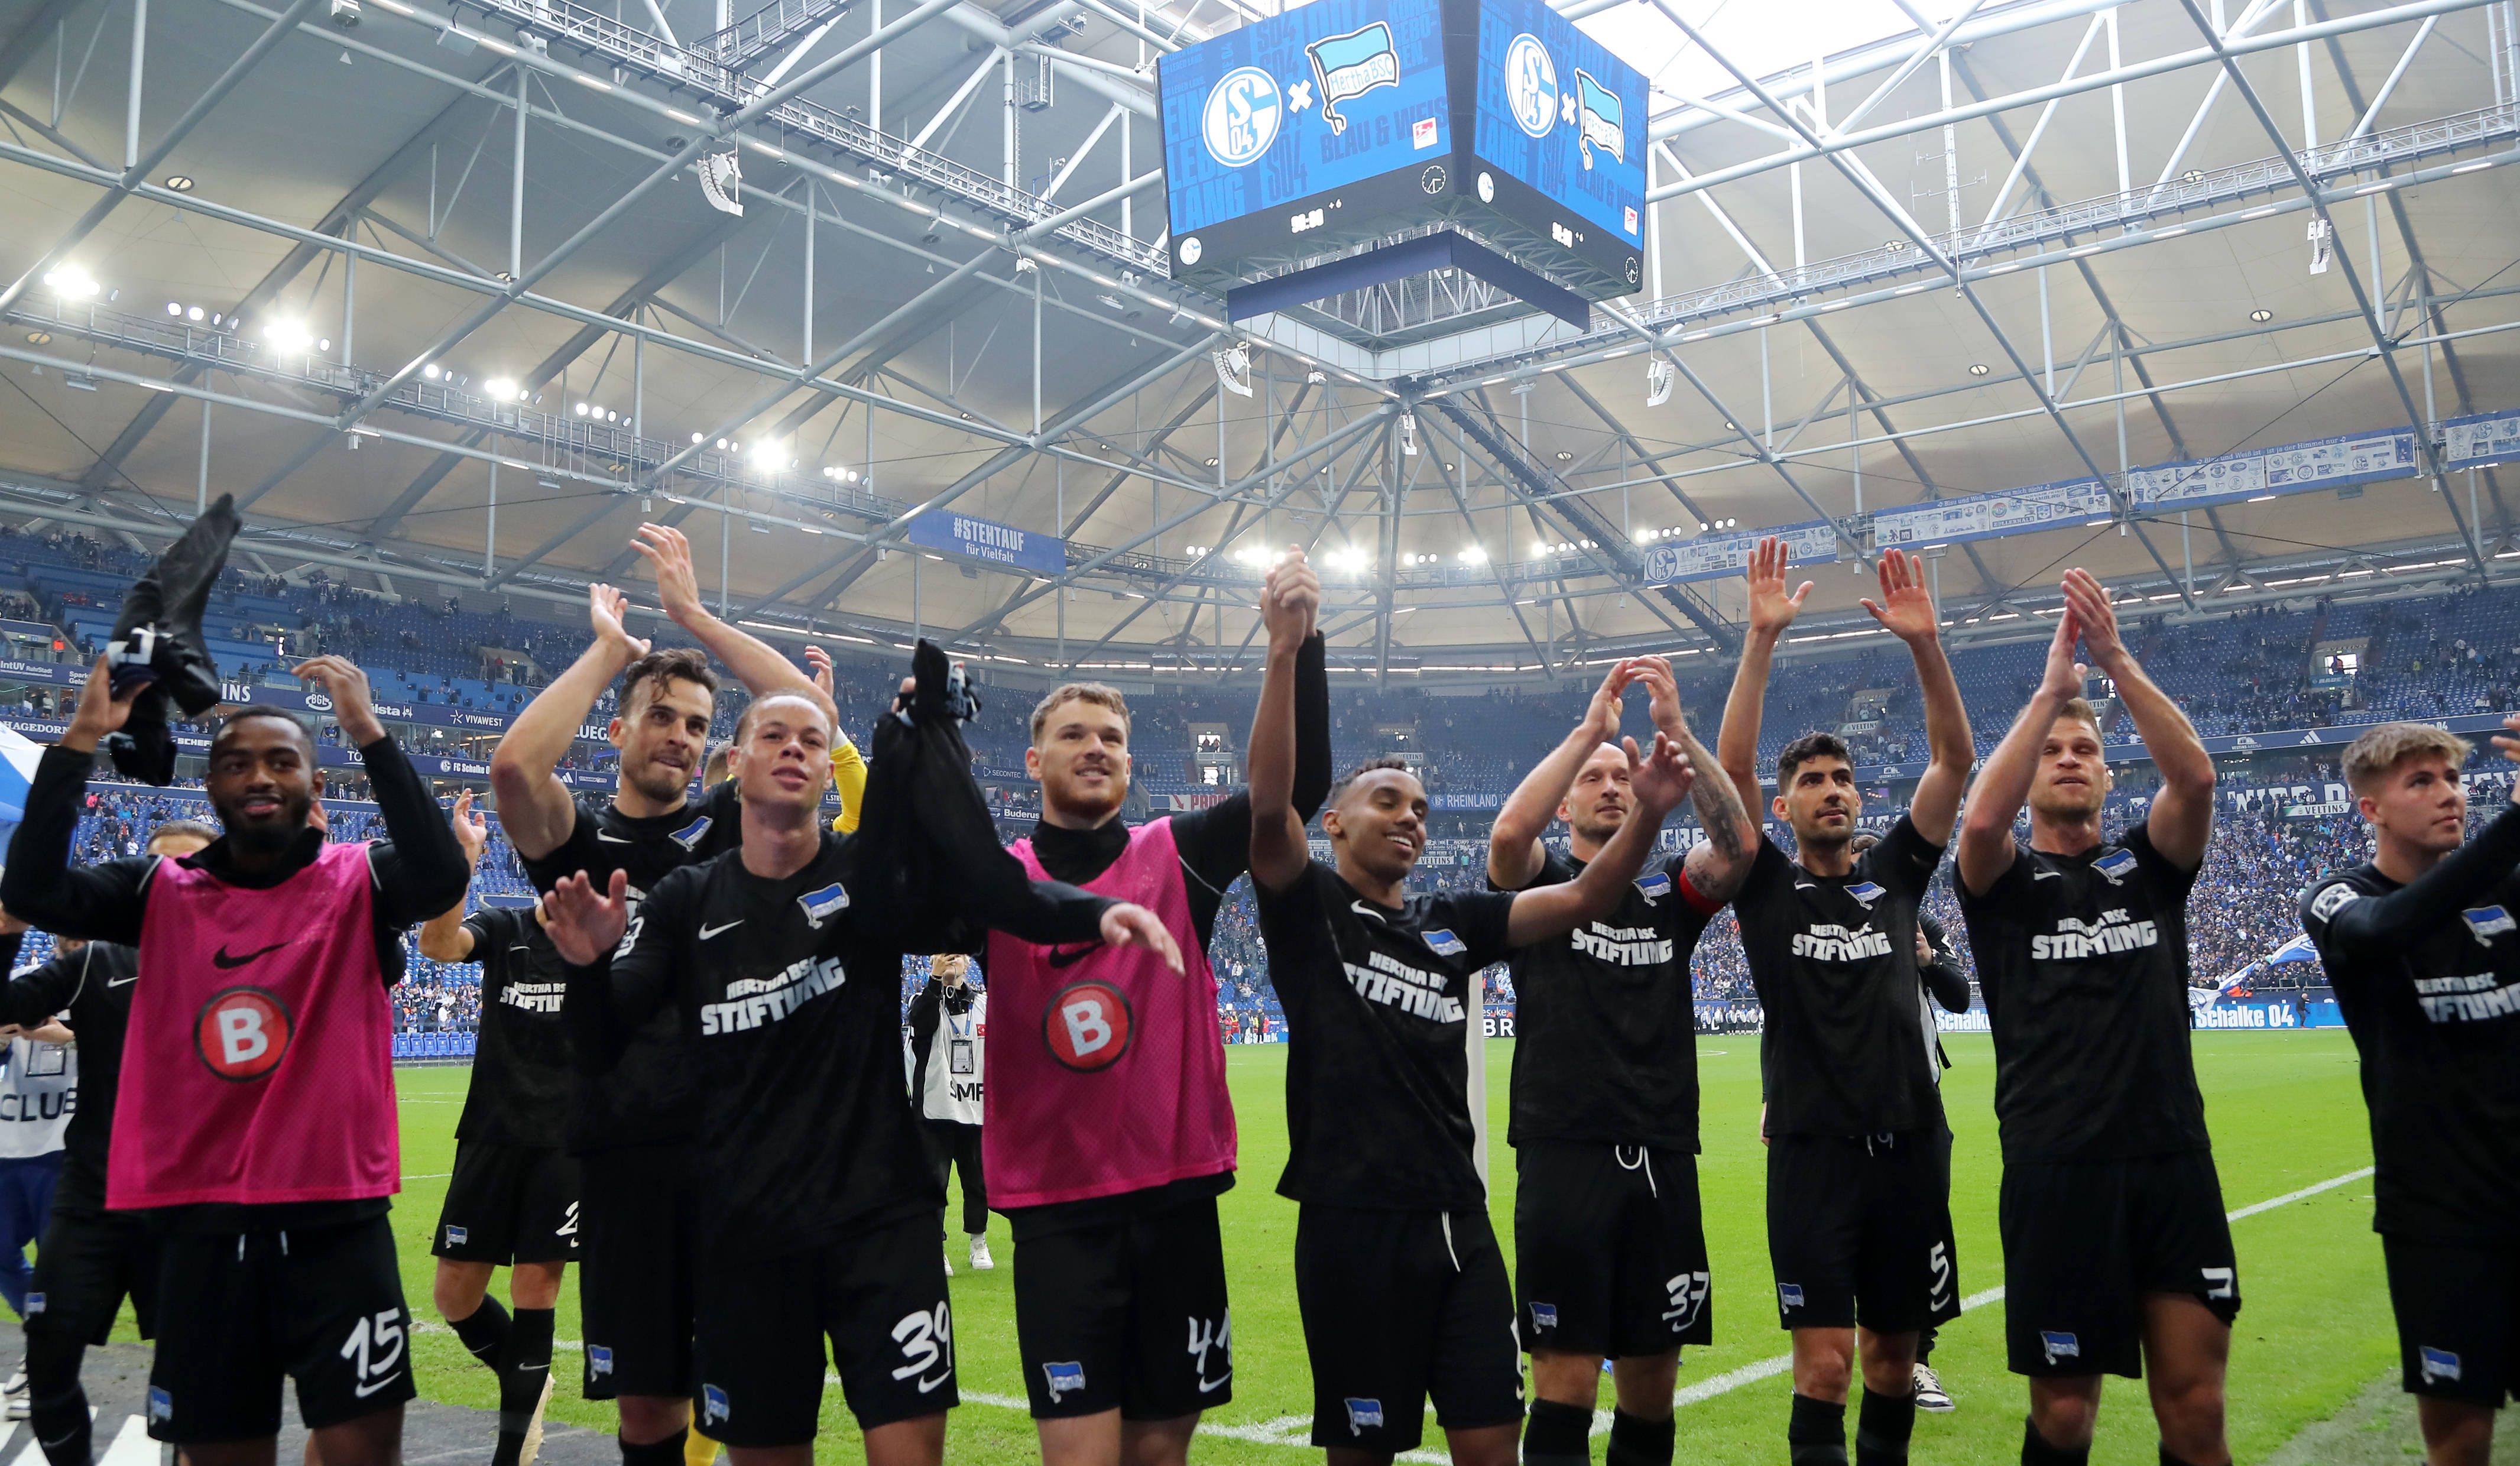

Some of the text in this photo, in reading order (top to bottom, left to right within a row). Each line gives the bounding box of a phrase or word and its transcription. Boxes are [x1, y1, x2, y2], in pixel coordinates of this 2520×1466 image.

[1320, 120, 1371, 164] BLAU
[2298, 439, 2324, 449] Himmel
[953, 517, 1024, 552] #STEHTAUF
[965, 542, 1014, 563] für Vielfalt
[1, 660, 25, 670] IntUV
[26, 666, 52, 674] RuhrStadt
[312, 693, 327, 705] BGL
[4, 721, 70, 735] HAGEDORN
[465, 714, 503, 727] VIVAWEST
[575, 724, 610, 742] UEG.
[453, 762, 461, 772] FC
[462, 763, 485, 774] Schalke
[992, 769, 1021, 779] SECONTEC
[1004, 808, 1040, 819] Buderus
[1447, 794, 1497, 808] RHEINLAND
[2305, 805, 2344, 815] VELTINS
[2103, 908, 2130, 923] BSC
[1571, 928, 1673, 966] STIFTUNG
[1792, 932, 1893, 962] STIFTUNG
[2032, 920, 2158, 960] STIFTUNG
[727, 955, 817, 1001] HERTHA BSC
[1368, 951, 1428, 986] HERTHA
[514, 981, 552, 994] HERTHA
[700, 956, 847, 1036] STIFTUNG
[1342, 962, 1465, 1025] STIFTUNG
[1061, 999, 1113, 1058] B
[2196, 1004, 2295, 1029] Schalke 04
[217, 1007, 268, 1065] B
[0, 1088, 77, 1122] CLUB
[1662, 1270, 1709, 1322] 37
[341, 1307, 404, 1380] 15
[891, 1301, 951, 1382] 39
